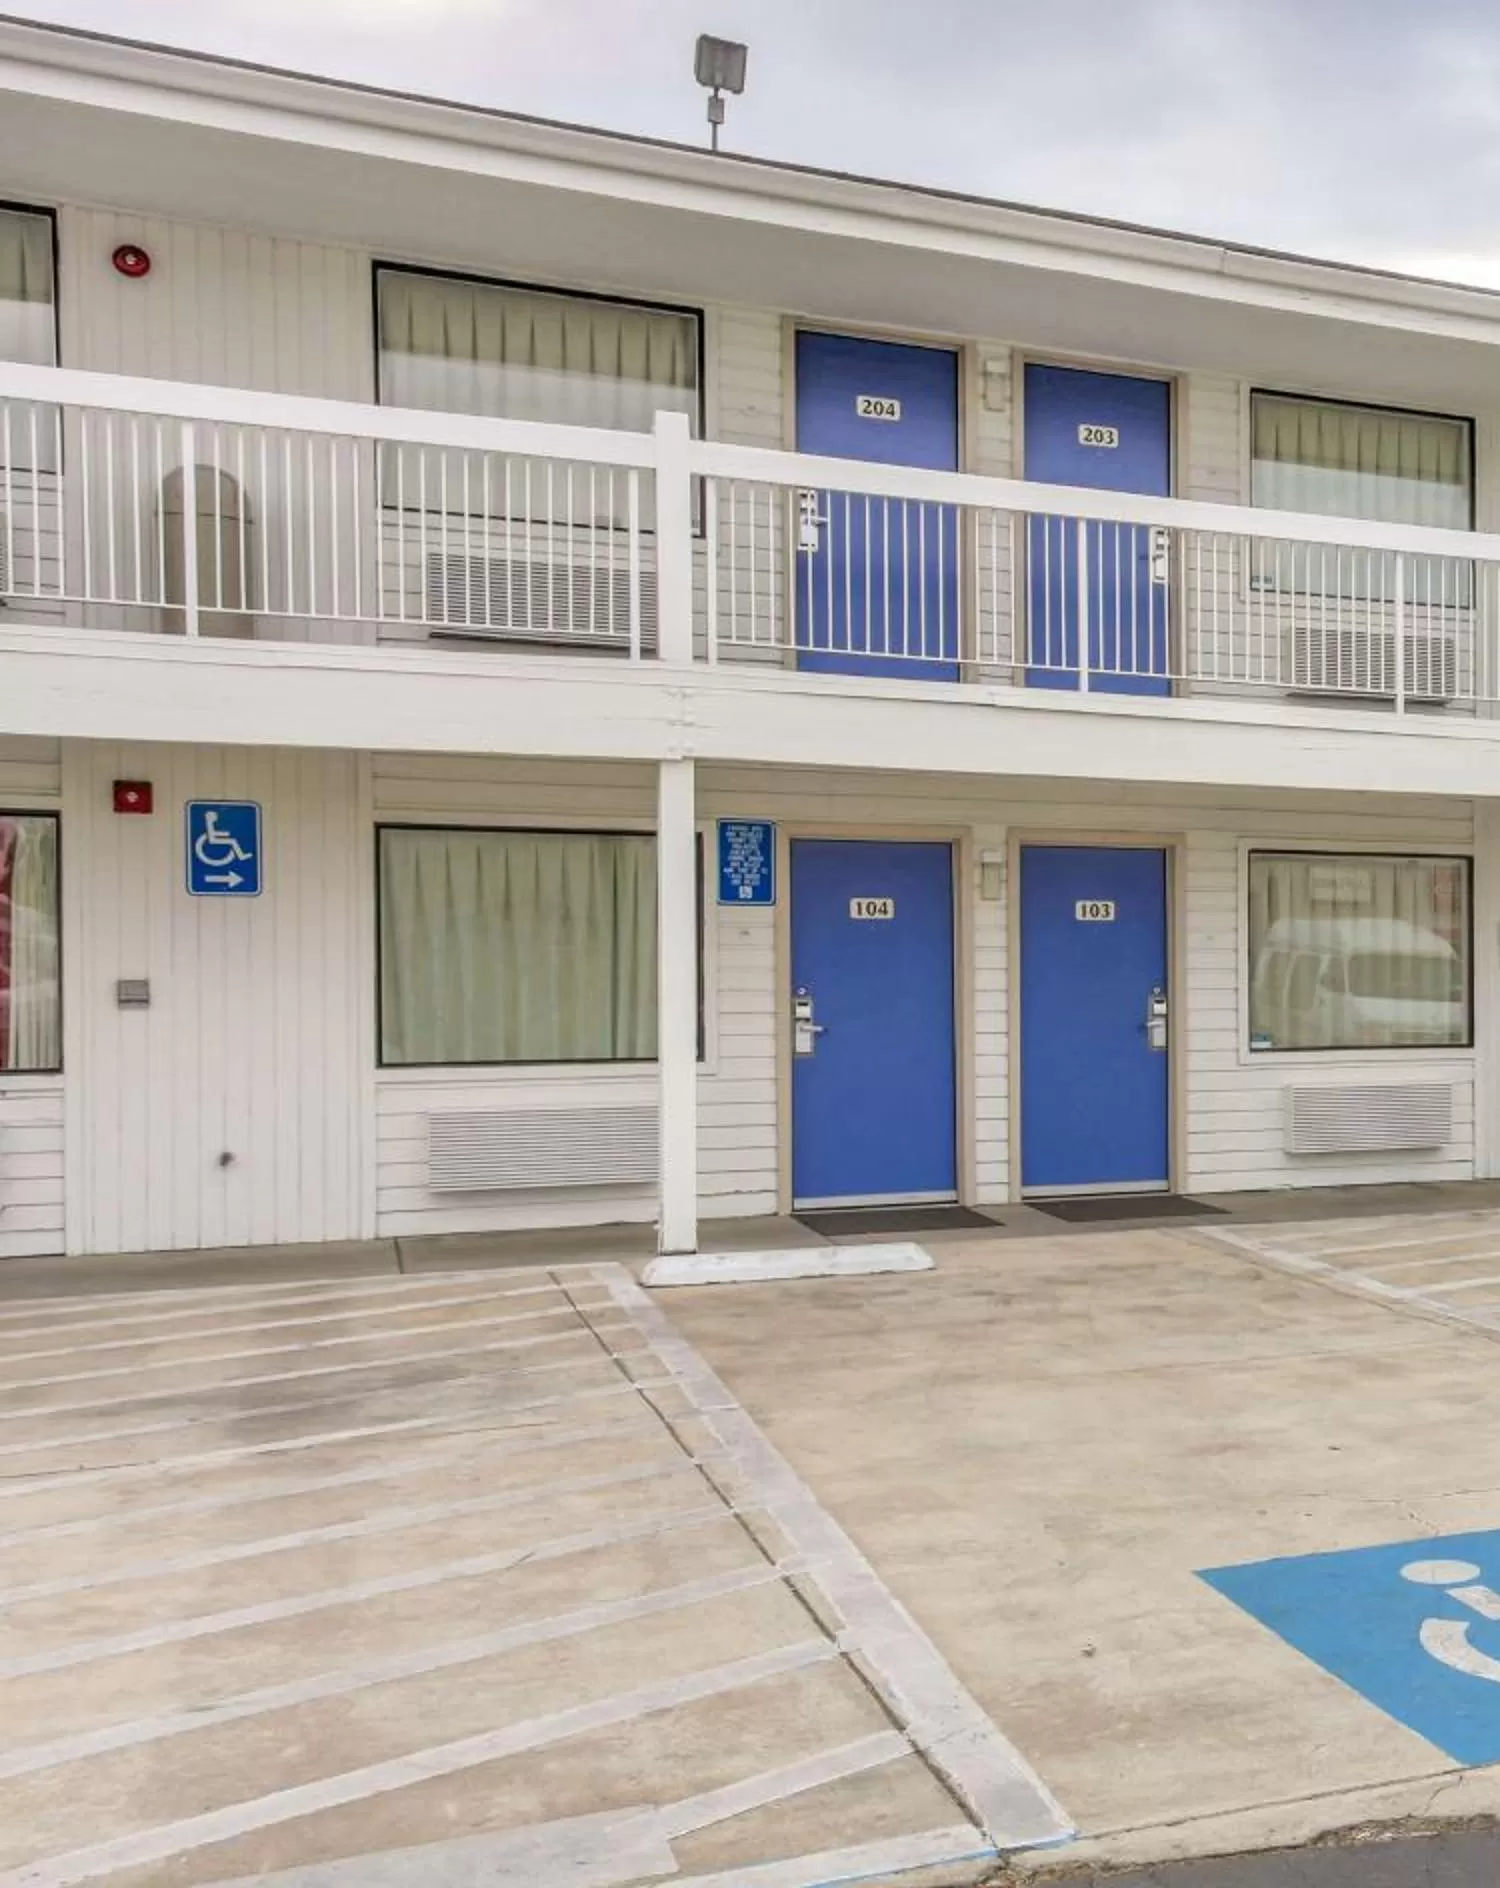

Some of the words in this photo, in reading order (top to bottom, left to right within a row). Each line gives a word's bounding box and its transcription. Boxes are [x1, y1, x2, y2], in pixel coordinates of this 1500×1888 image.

[863, 400, 896, 417] 204
[1083, 427, 1115, 445] 203
[856, 901, 889, 917] 104
[1081, 903, 1111, 919] 103
